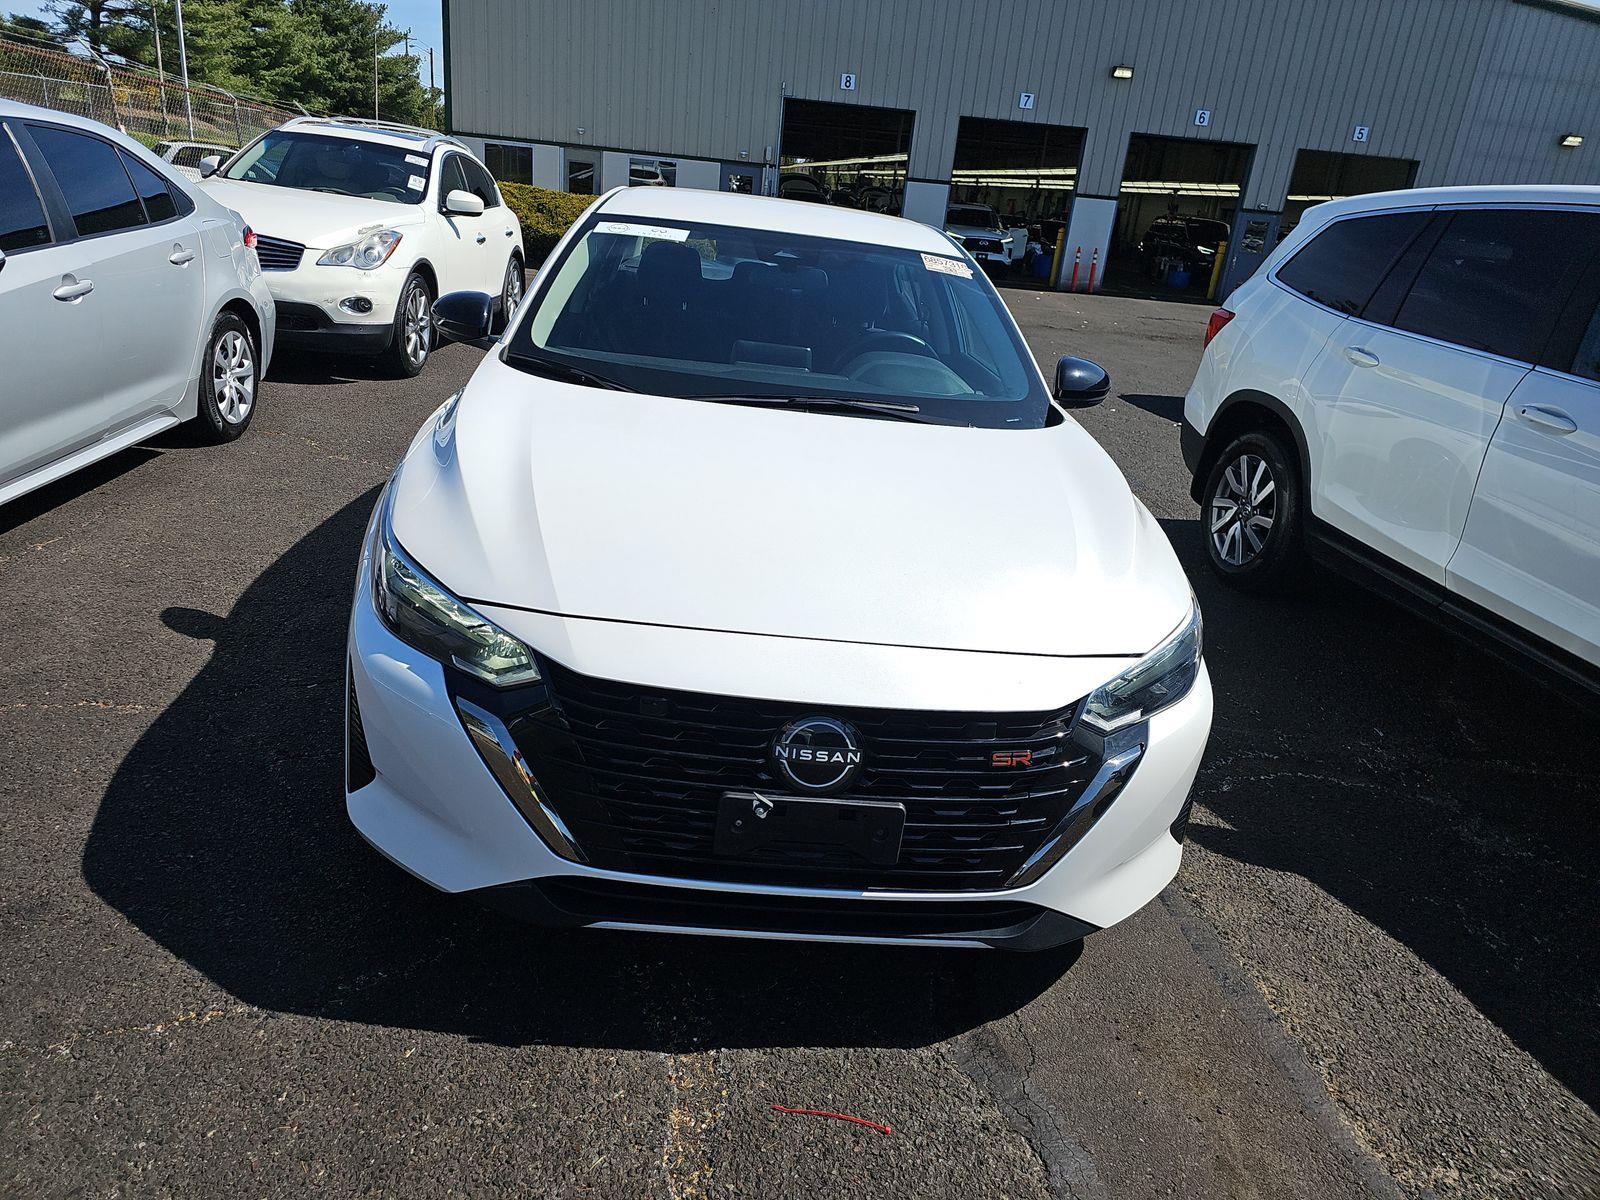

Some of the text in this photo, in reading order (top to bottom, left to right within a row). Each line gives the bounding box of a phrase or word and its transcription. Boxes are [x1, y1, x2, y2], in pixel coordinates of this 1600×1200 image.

[845, 75, 851, 88] 8
[1024, 94, 1031, 107] 7
[1198, 111, 1206, 124] 6
[1357, 128, 1365, 140] 5
[775, 745, 860, 763] NISSAN
[992, 751, 1031, 767] SR
